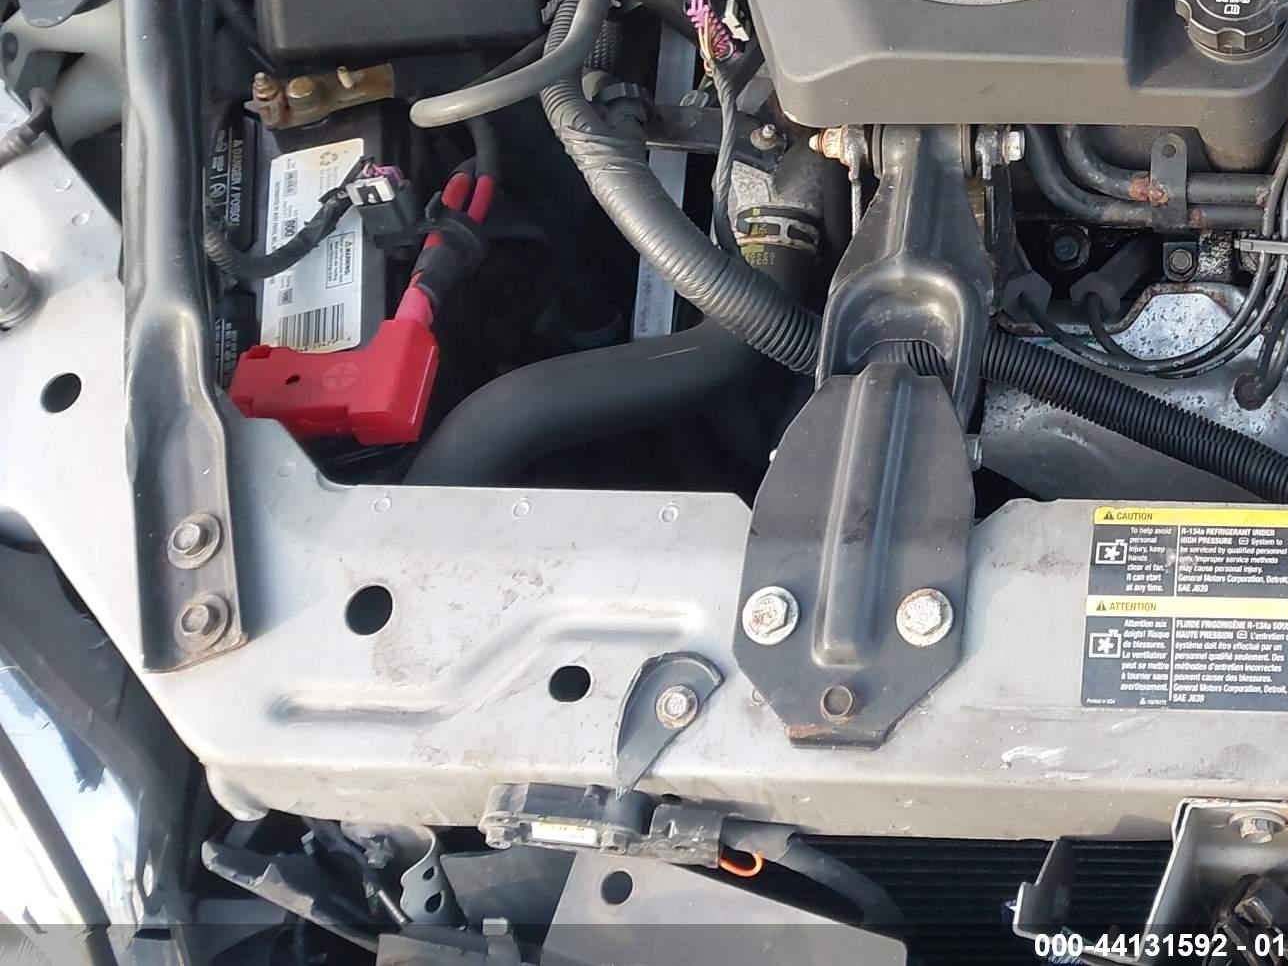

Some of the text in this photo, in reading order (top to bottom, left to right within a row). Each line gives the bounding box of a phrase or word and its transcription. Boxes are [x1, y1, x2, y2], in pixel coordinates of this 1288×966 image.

[231, 148, 242, 185] DANGER
[1117, 510, 1152, 519] CAUTION
[1110, 600, 1156, 611] ATTENTION
